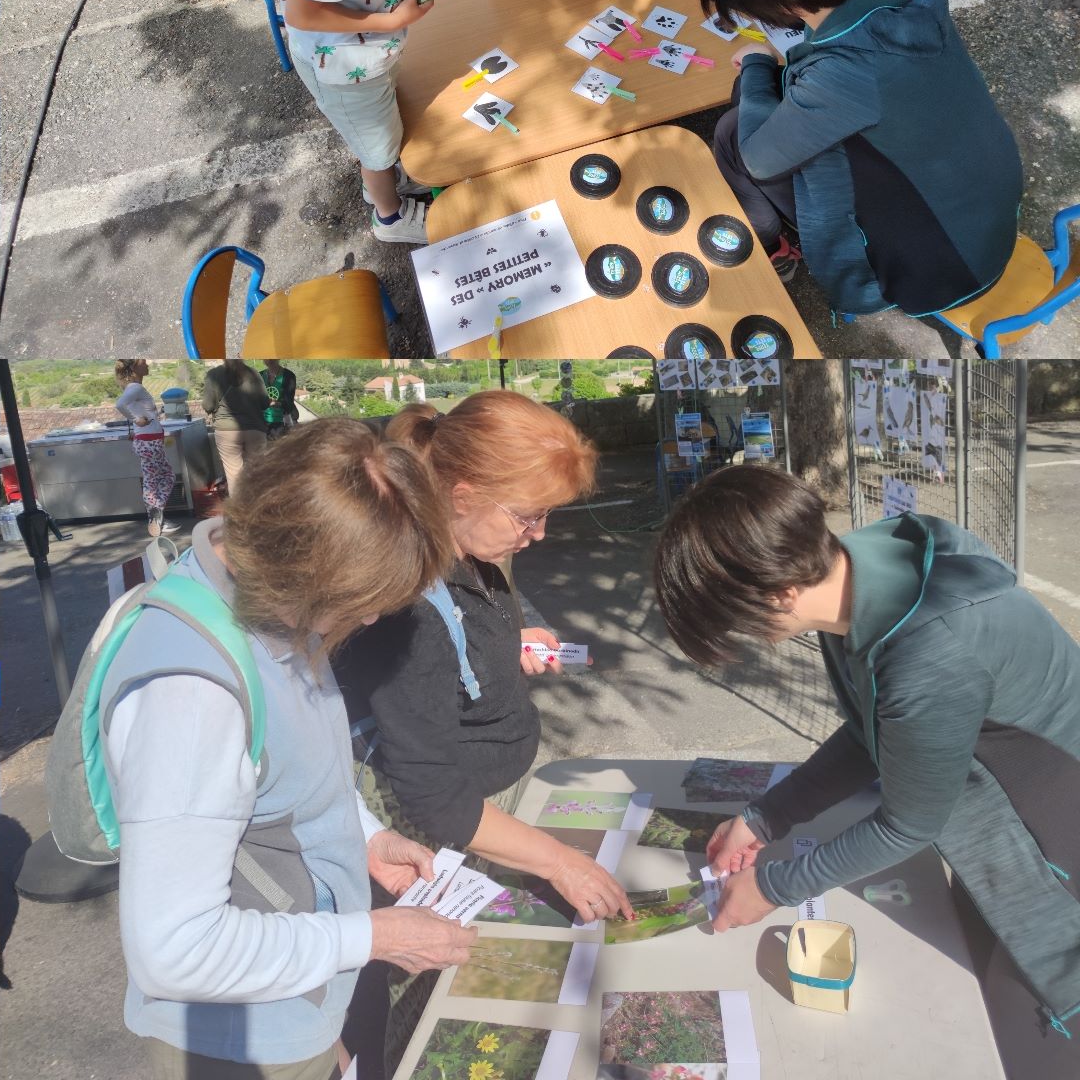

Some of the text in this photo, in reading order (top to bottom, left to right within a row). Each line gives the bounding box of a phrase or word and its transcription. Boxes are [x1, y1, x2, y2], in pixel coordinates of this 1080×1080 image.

[453, 248, 540, 290] PETITES BÊTES
[486, 263, 544, 293] MEMORY
[449, 288, 475, 307] DES
